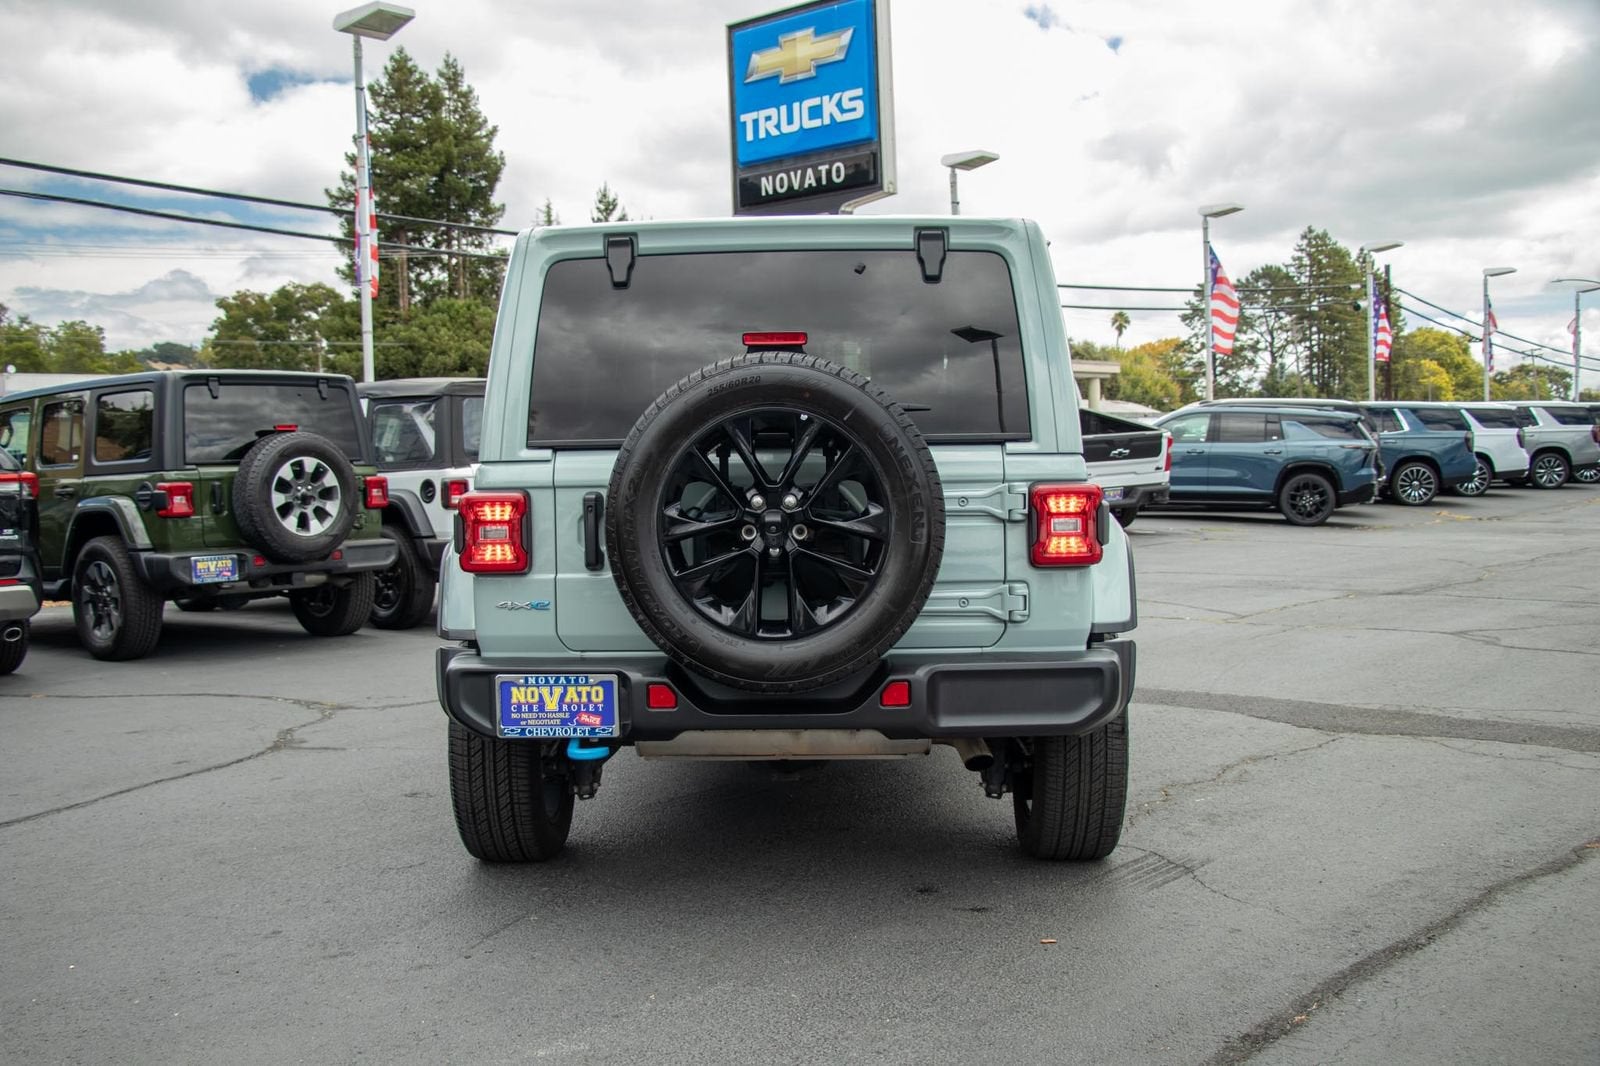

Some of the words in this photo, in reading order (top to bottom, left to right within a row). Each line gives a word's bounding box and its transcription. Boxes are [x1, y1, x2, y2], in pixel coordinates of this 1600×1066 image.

[740, 88, 864, 141] TRUCKS
[761, 162, 845, 196] NOVATO
[511, 686, 604, 711] NOVATO
[525, 728, 591, 737] CHEVROLET
